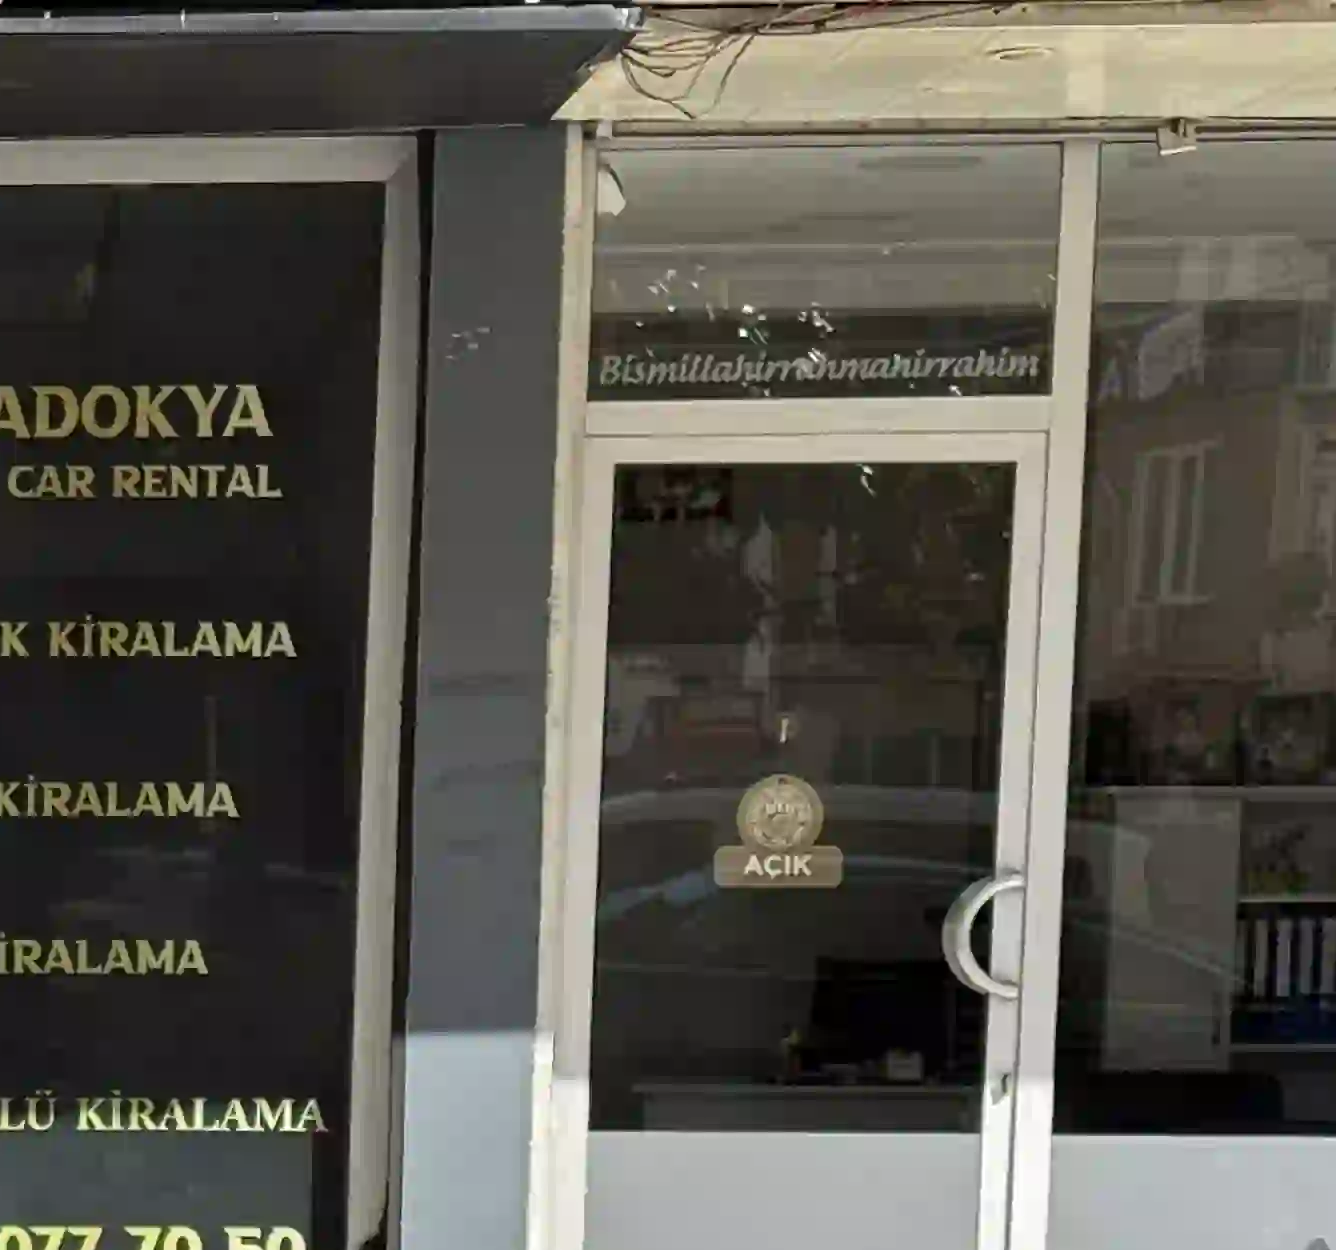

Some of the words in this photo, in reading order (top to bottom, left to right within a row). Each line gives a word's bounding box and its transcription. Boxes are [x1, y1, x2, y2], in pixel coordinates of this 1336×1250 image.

[7, 464, 97, 499] CAR
[111, 464, 283, 499] RENTAL
[48, 613, 297, 659] KİRALAMA
[743, 854, 813, 880] AÇIK
[76, 1089, 329, 1133] KİRALAMA
